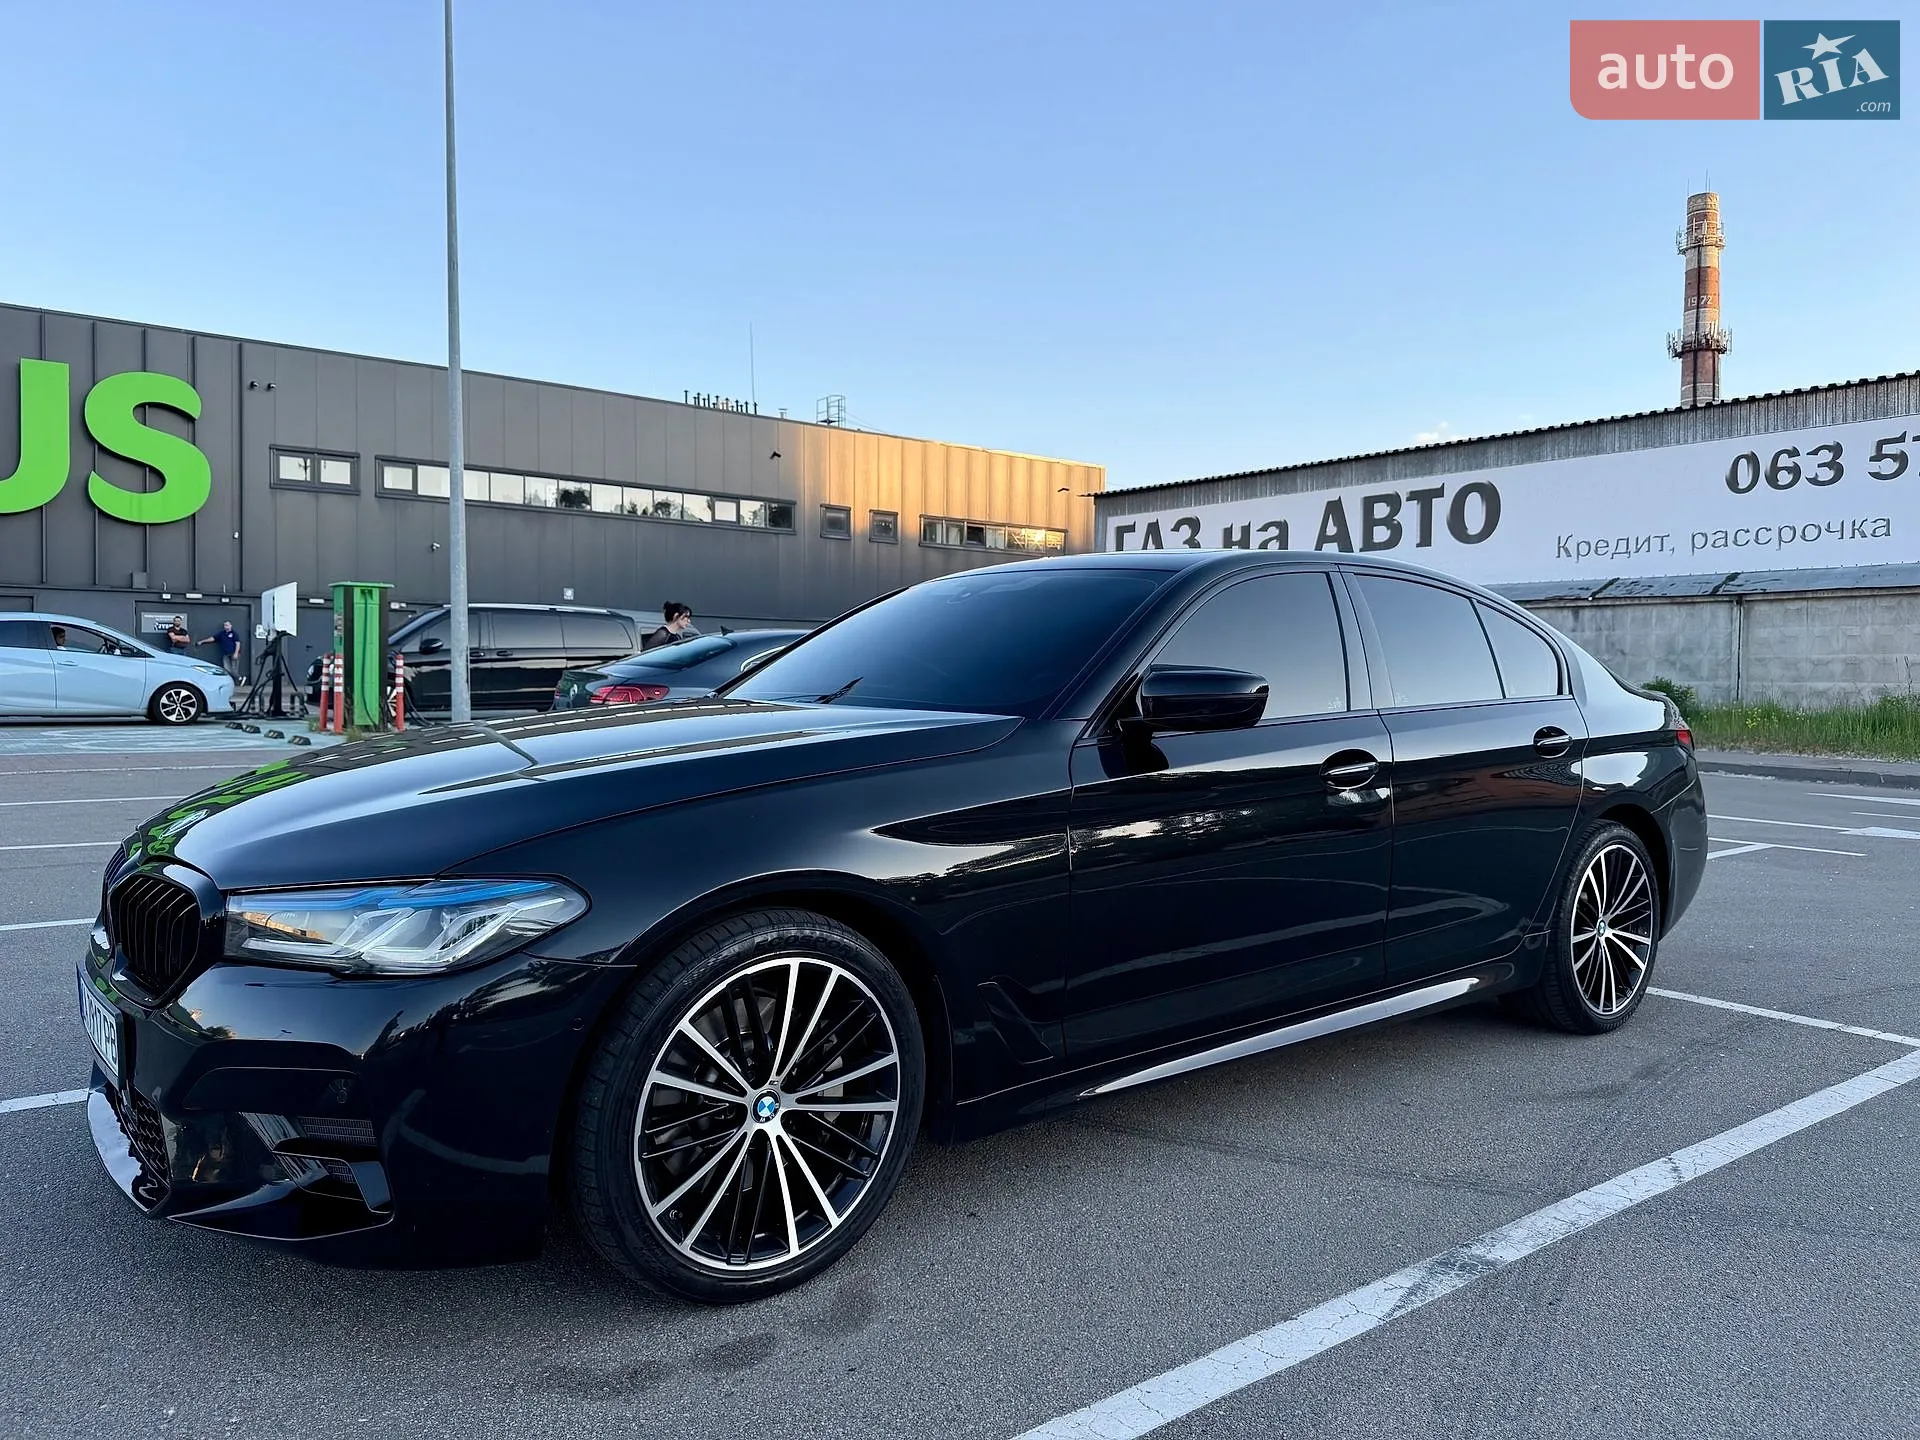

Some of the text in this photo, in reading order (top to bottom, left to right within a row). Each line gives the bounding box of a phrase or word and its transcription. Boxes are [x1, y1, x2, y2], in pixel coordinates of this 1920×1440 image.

[1688, 295, 1713, 307] 1972
[1725, 430, 1920, 494] 063 5
[1115, 480, 1501, 552] ГАЗ на АВТО
[1555, 517, 1891, 563] Кредит, рассрочка
